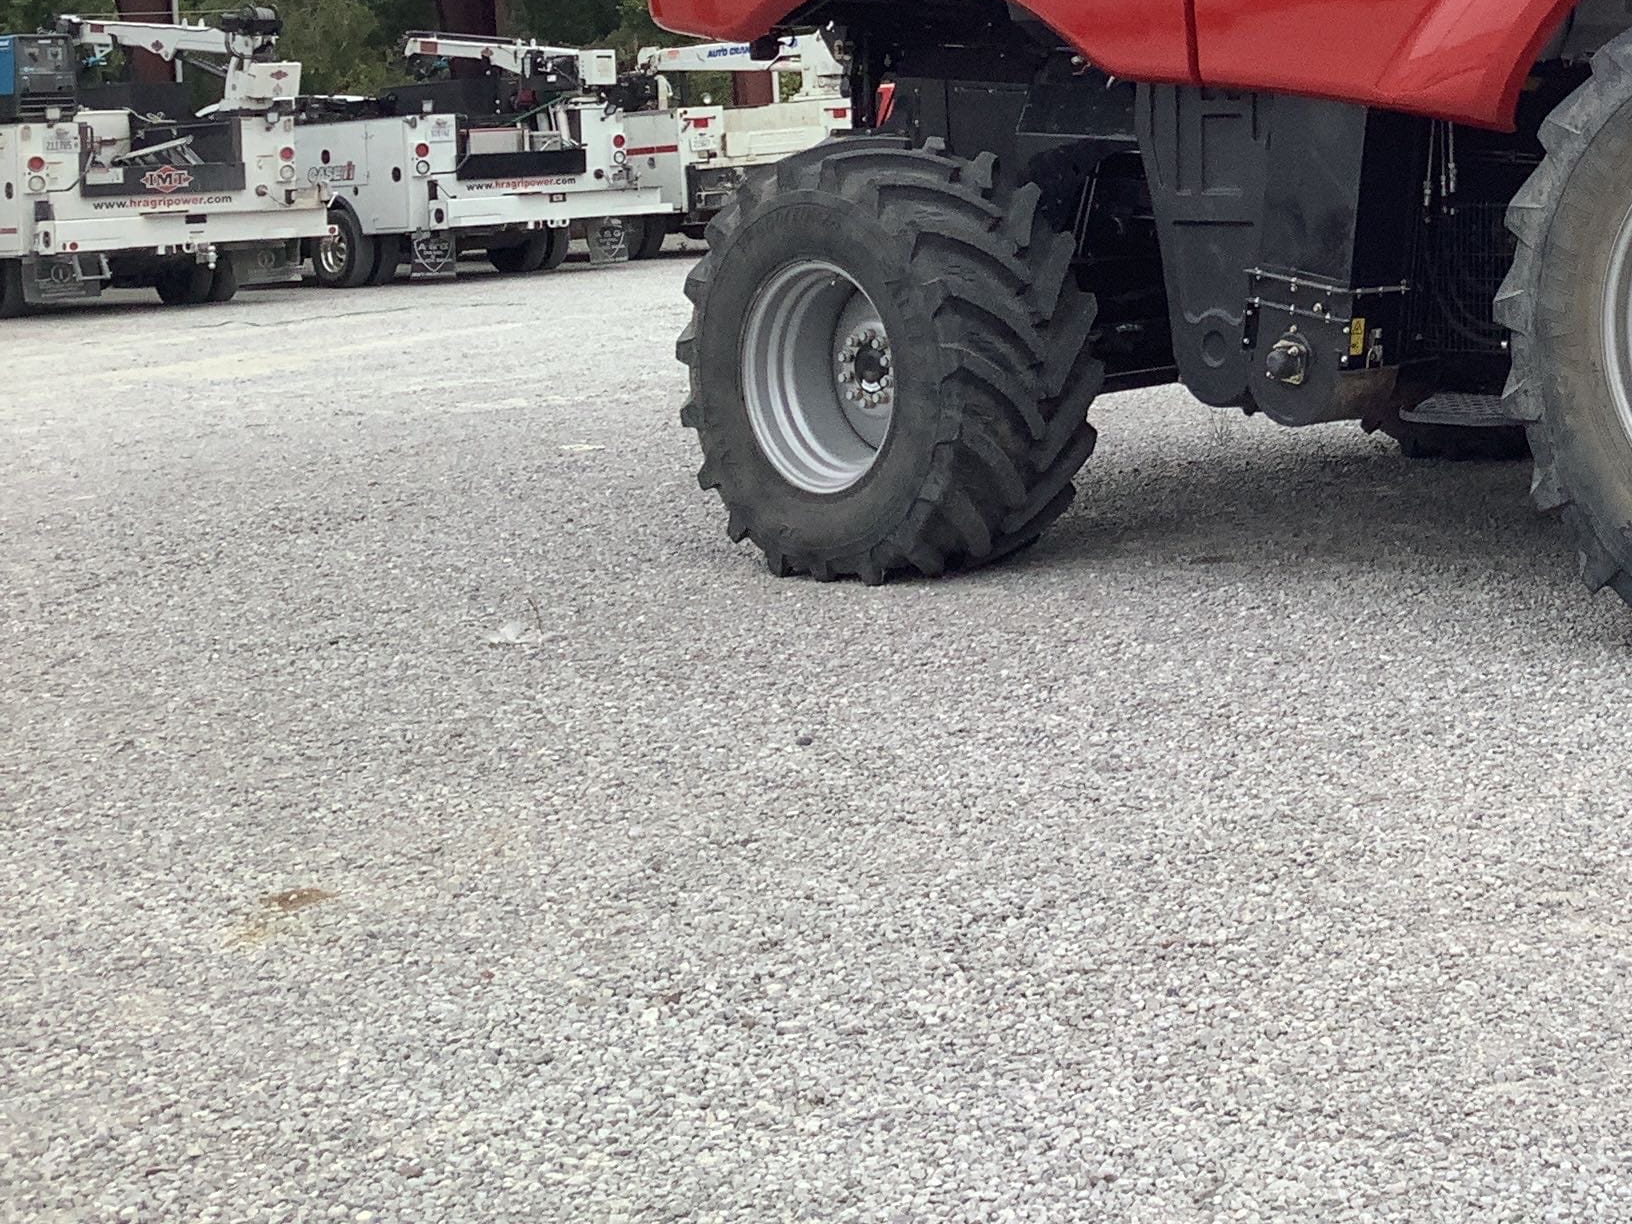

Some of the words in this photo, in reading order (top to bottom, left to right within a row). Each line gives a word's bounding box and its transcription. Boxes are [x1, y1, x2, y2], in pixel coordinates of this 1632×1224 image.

[149, 174, 187, 186] IMT
[466, 177, 576, 191] www.hragripower.com
[93, 194, 232, 210] www.hragripower.com
